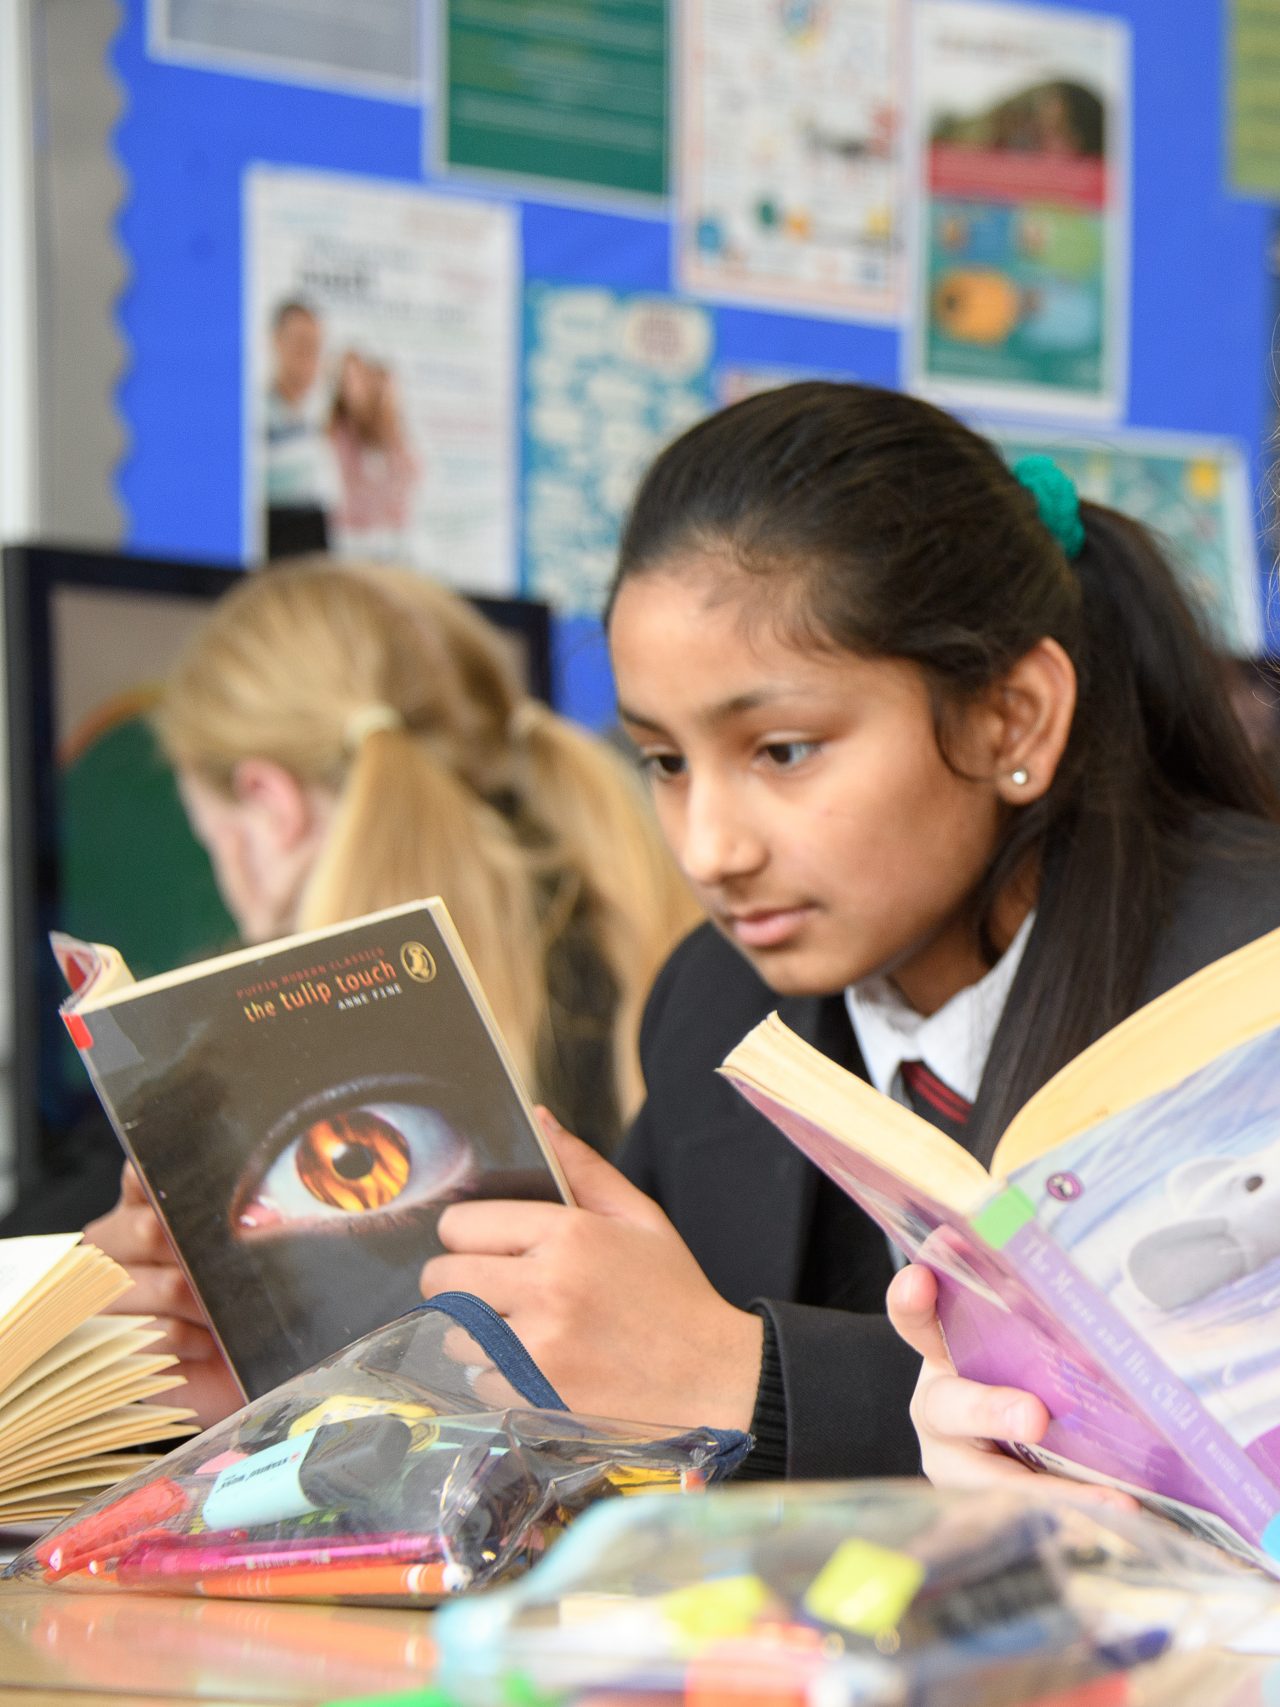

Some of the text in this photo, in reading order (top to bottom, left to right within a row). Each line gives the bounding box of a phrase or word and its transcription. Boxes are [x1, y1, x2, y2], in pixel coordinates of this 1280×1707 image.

[243, 960, 397, 1023] the tulip touch
[336, 982, 403, 1010] ANNE FINE
[1151, 1382, 1201, 1431] Child
